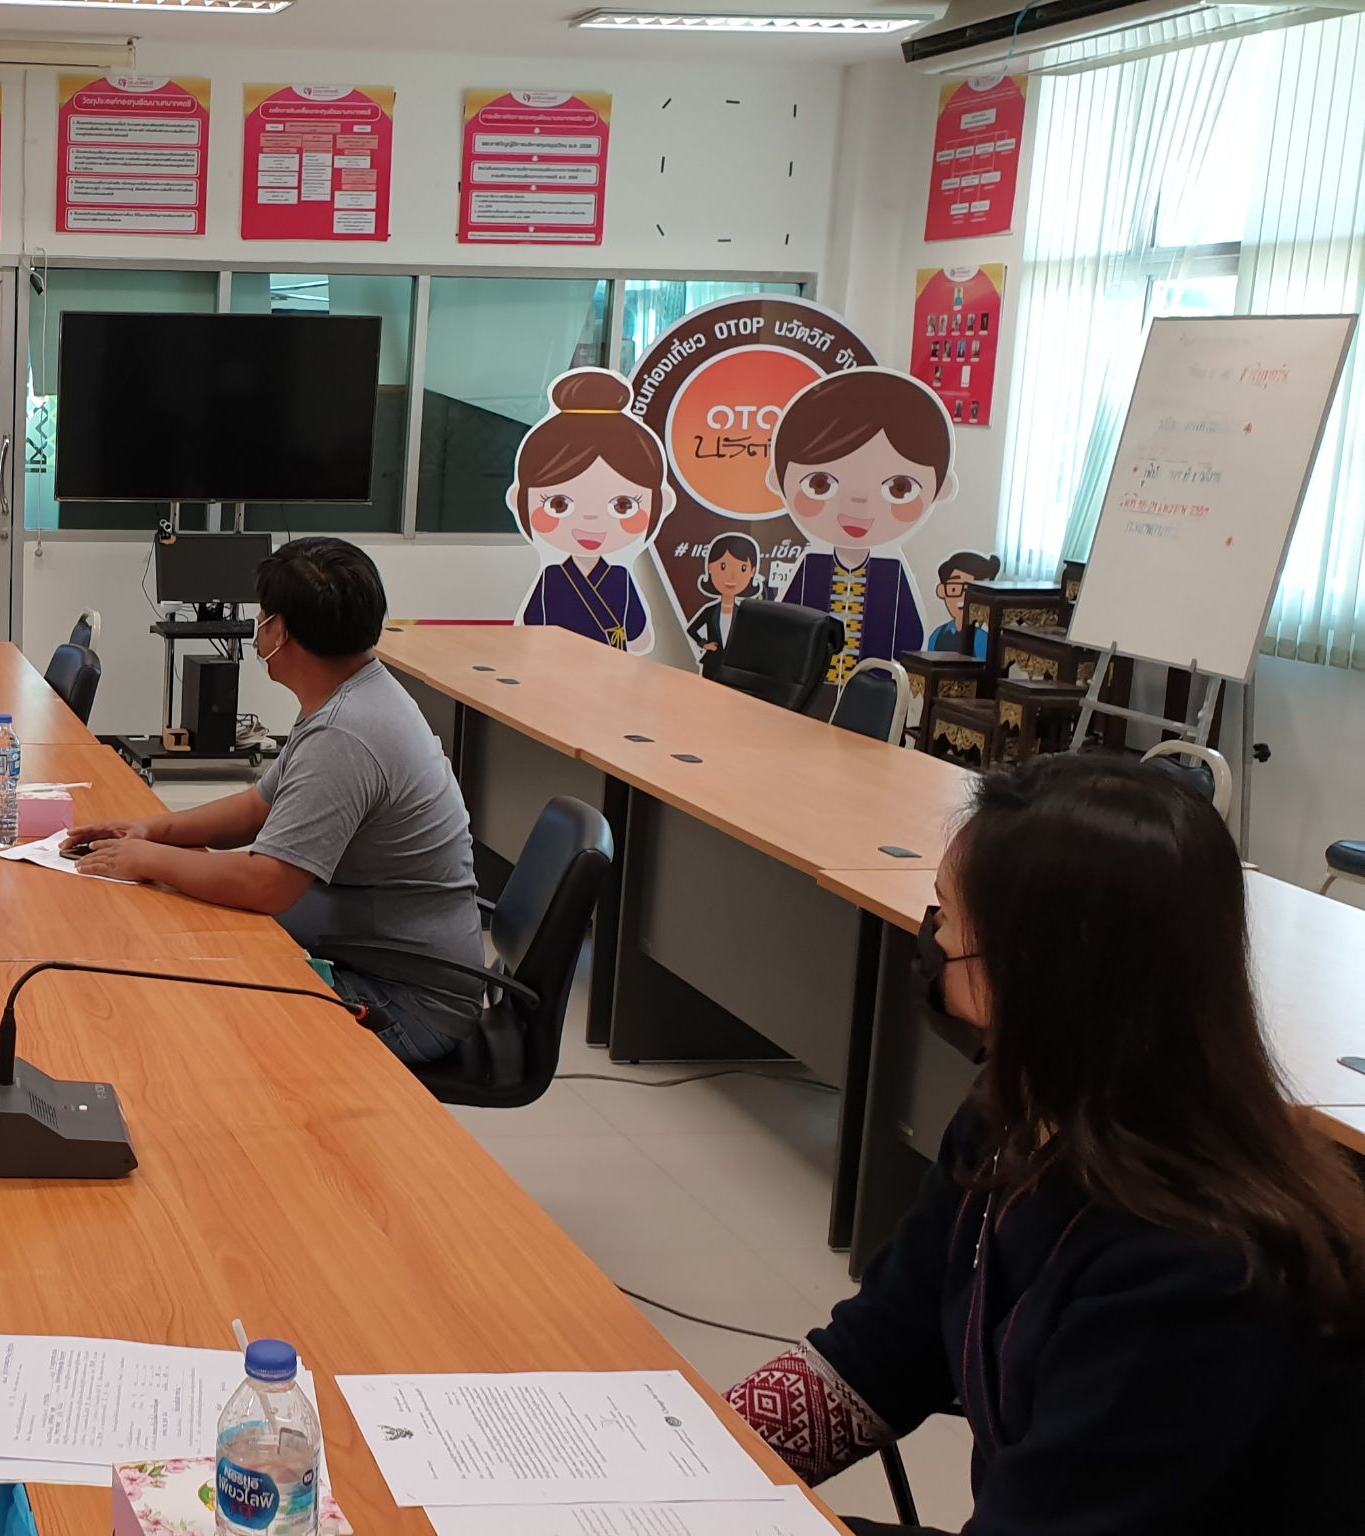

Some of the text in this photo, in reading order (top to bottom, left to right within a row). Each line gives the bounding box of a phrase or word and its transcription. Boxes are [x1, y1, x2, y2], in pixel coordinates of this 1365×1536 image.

[631, 332, 706, 423] ชนท่องเที่ยว
[714, 317, 765, 340] OTOP
[774, 319, 835, 352] นวัตวิถี
[706, 404, 783, 430] OTO
